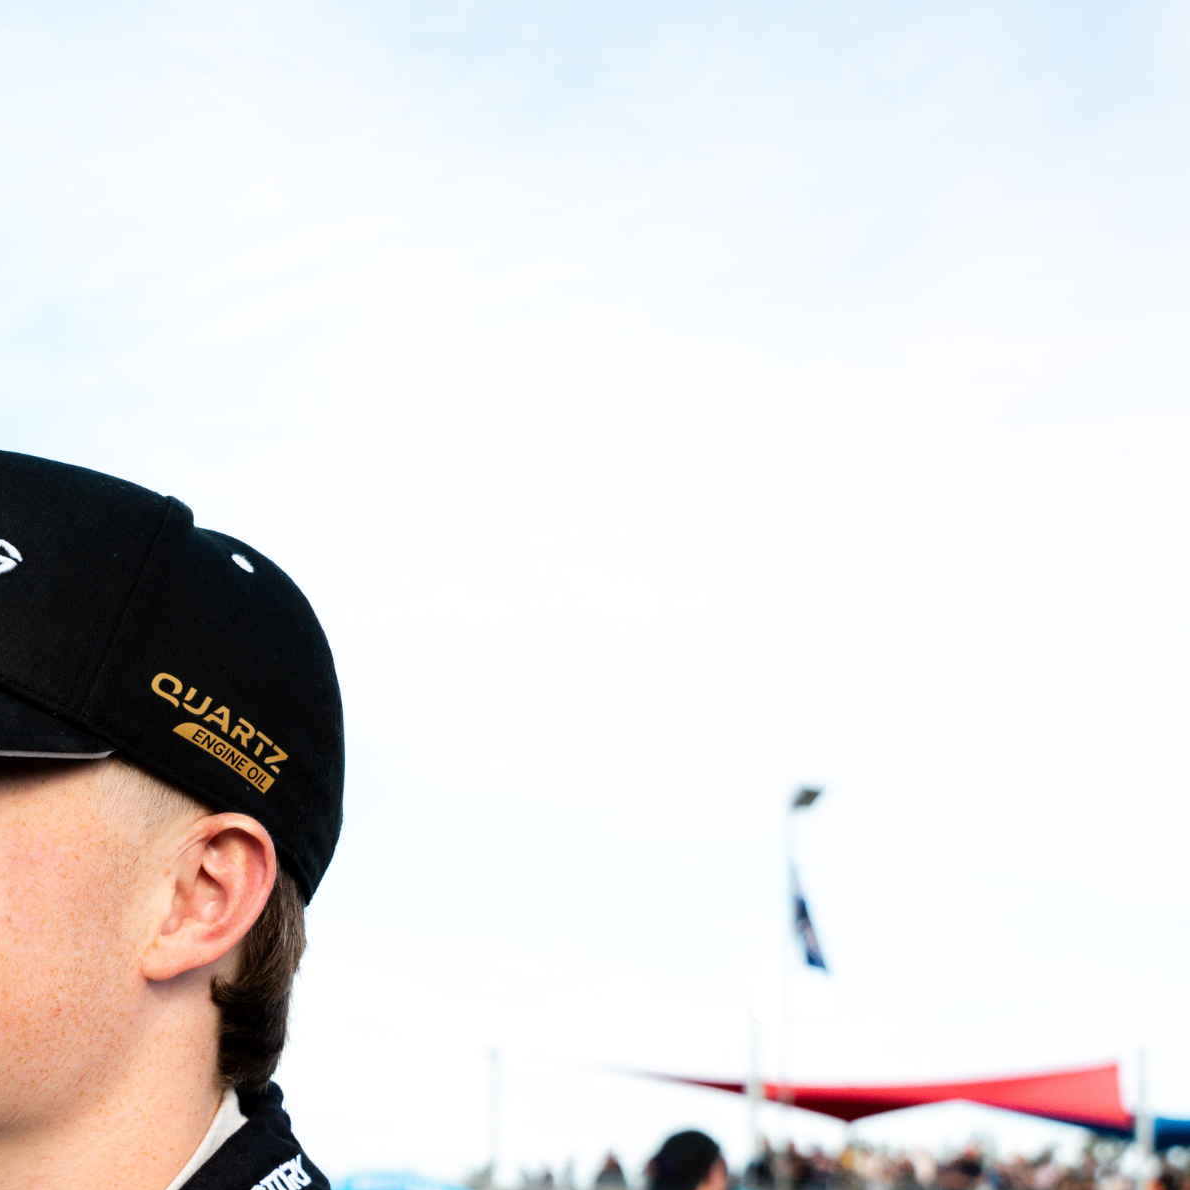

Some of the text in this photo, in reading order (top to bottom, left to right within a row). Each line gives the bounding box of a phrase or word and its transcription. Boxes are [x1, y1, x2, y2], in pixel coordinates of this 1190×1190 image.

[151, 672, 289, 774] QUARTZ
[192, 729, 268, 790] ENGINE OIL
